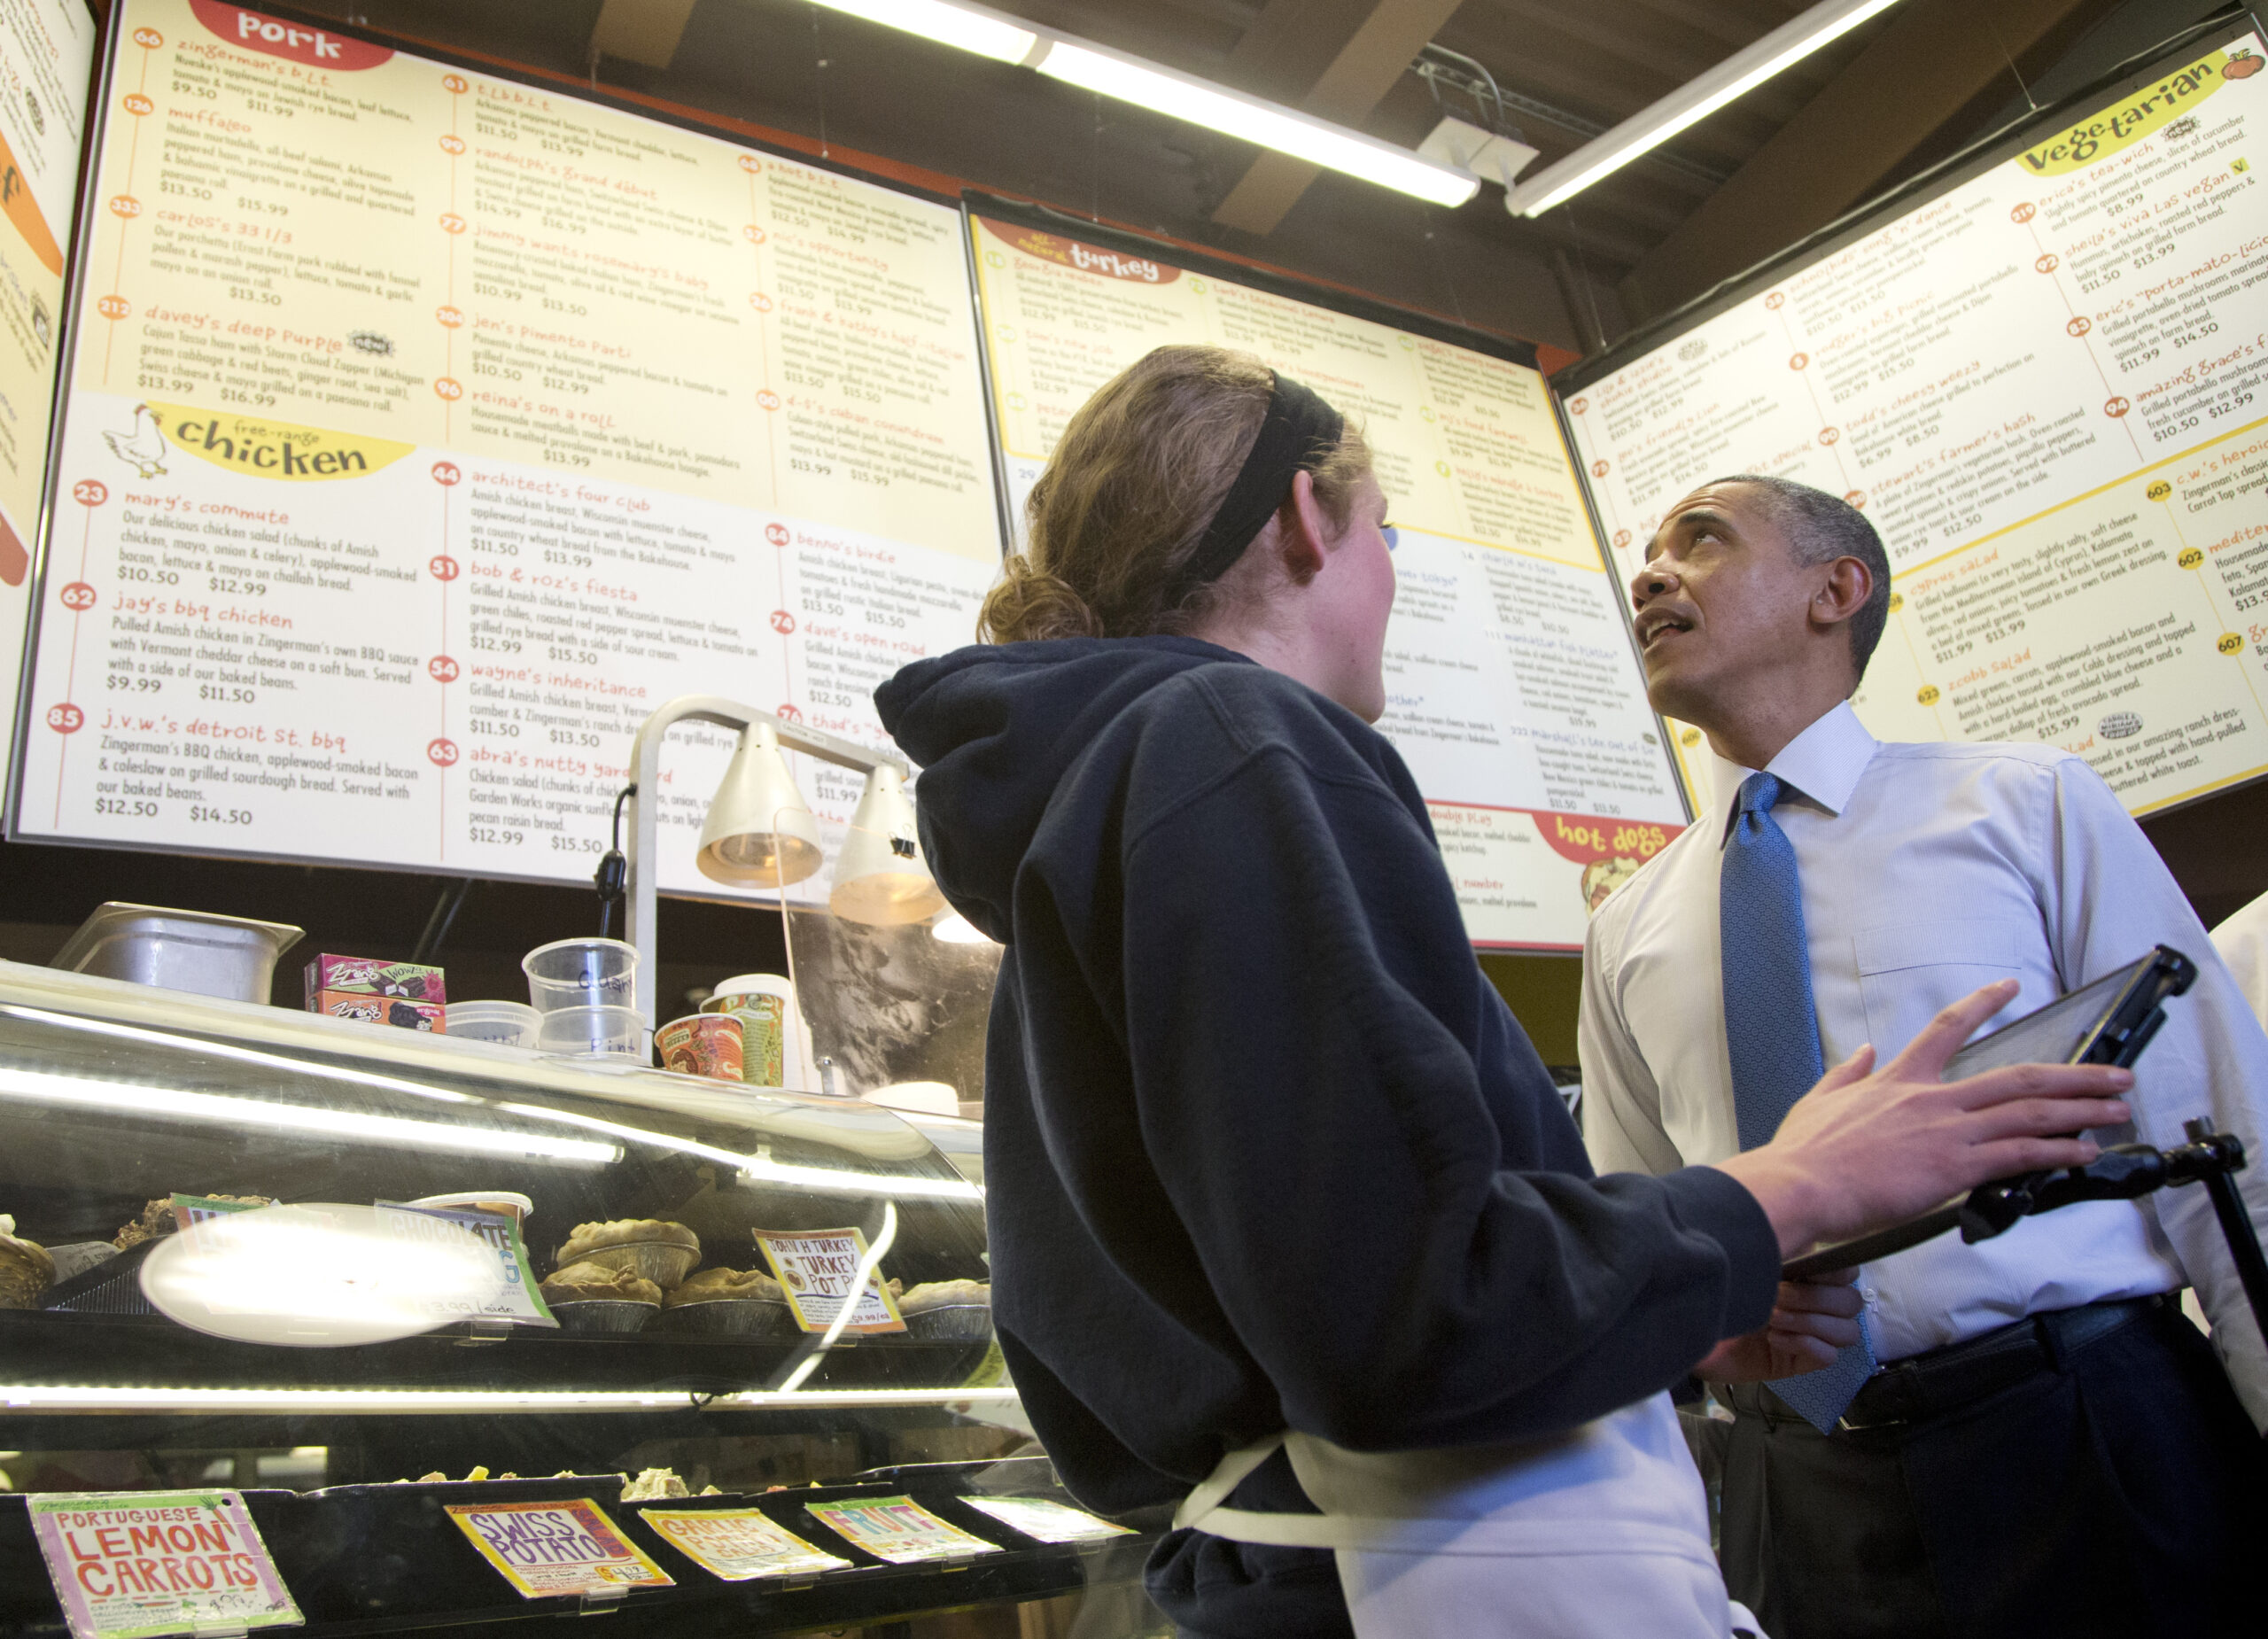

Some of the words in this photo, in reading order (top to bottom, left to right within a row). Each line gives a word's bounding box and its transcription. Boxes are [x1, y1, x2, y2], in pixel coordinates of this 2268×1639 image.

[136, 31, 160, 46] 66
[237, 12, 342, 59] pork
[126, 97, 151, 112] 126
[171, 80, 217, 99] $9.50
[247, 98, 294, 117] $11.99
[2024, 63, 2213, 170] Vegetarian
[113, 199, 142, 214] 333
[159, 177, 213, 200] $13.50
[237, 197, 289, 216] $15.99
[2107, 193, 2143, 217] $8.99
[1070, 244, 1160, 282] turkey
[2133, 243, 2175, 269] $13.99
[2081, 269, 2121, 293] $11.50
[100, 300, 129, 315] 212
[229, 285, 282, 306] $13.50
[144, 305, 220, 330] davey's
[227, 320, 276, 340] deep
[282, 330, 342, 353] purple
[2173, 322, 2218, 348] $14.50
[2119, 348, 2160, 372] $11.99
[471, 361, 522, 382] $10.50
[542, 376, 588, 394] $12.99
[2136, 365, 2195, 402] amazing
[2198, 345, 2254, 376] grace's
[136, 373, 194, 392] $13.99
[220, 387, 276, 407] $16.99
[438, 381, 462, 397] 96
[2147, 413, 2171, 429] fresh
[2172, 396, 2215, 419] cucumber
[2216, 390, 2229, 400] on
[2230, 373, 2261, 396] grilled
[2208, 392, 2253, 418] $12.99
[2153, 416, 2199, 442] $10.50
[177, 421, 368, 475] chicken
[543, 448, 590, 467] $13.99
[434, 467, 459, 481] 44
[74, 485, 105, 501] 23
[471, 471, 568, 498] architect's
[575, 485, 609, 503] four
[616, 496, 650, 512] club
[2148, 484, 2171, 501] 603
[125, 493, 191, 511] mary's
[198, 504, 289, 524] commute
[470, 537, 518, 555] $11.50
[544, 549, 592, 567] $13.99
[2178, 550, 2203, 567] 602
[117, 565, 180, 585] $10.50
[208, 576, 267, 595] $12.99
[431, 561, 456, 576] 51
[63, 589, 94, 605] 62
[113, 596, 166, 614] jay's
[174, 599, 209, 622] bbq
[217, 606, 292, 629] chicken
[1984, 619, 2025, 643] $13.99
[470, 633, 522, 653] $12.99
[548, 646, 597, 664] $15.50
[1935, 641, 1973, 664] $11.99
[2218, 636, 2243, 653] 607
[430, 662, 457, 677] 54
[470, 664, 540, 684] wayne's
[548, 673, 645, 697] inheritance
[106, 674, 162, 693] $9.99
[198, 683, 255, 703] $11.50
[809, 689, 852, 707] $12.50
[49, 711, 80, 726] 85
[2037, 716, 2080, 739] $15.99
[470, 718, 519, 737] $11.50
[549, 728, 600, 748] $13.50
[430, 746, 456, 761] 63
[470, 746, 527, 766] abra's
[534, 756, 586, 776] nutty
[817, 787, 857, 802] $11.99
[95, 797, 159, 817] $12.50
[190, 805, 252, 825] $14.50
[470, 826, 524, 845] $12.99
[551, 835, 602, 853] $15.50
[1557, 815, 1607, 852] hot
[1612, 826, 1667, 857] dogs
[765, 1239, 799, 1254] JOHN
[802, 1239, 812, 1254] H
[811, 1239, 856, 1254] TURKEY
[796, 1254, 858, 1275] TURKEY
[808, 1274, 840, 1296] POT
[56, 1507, 201, 1529] PORTUGUESE
[470, 1511, 576, 1542] SWISS
[661, 1518, 759, 1537] GARLIC
[821, 1506, 938, 1538] FRUIT
[66, 1520, 232, 1562] LEMON
[489, 1534, 607, 1565] POTATO
[76, 1553, 259, 1596] CARROTS
